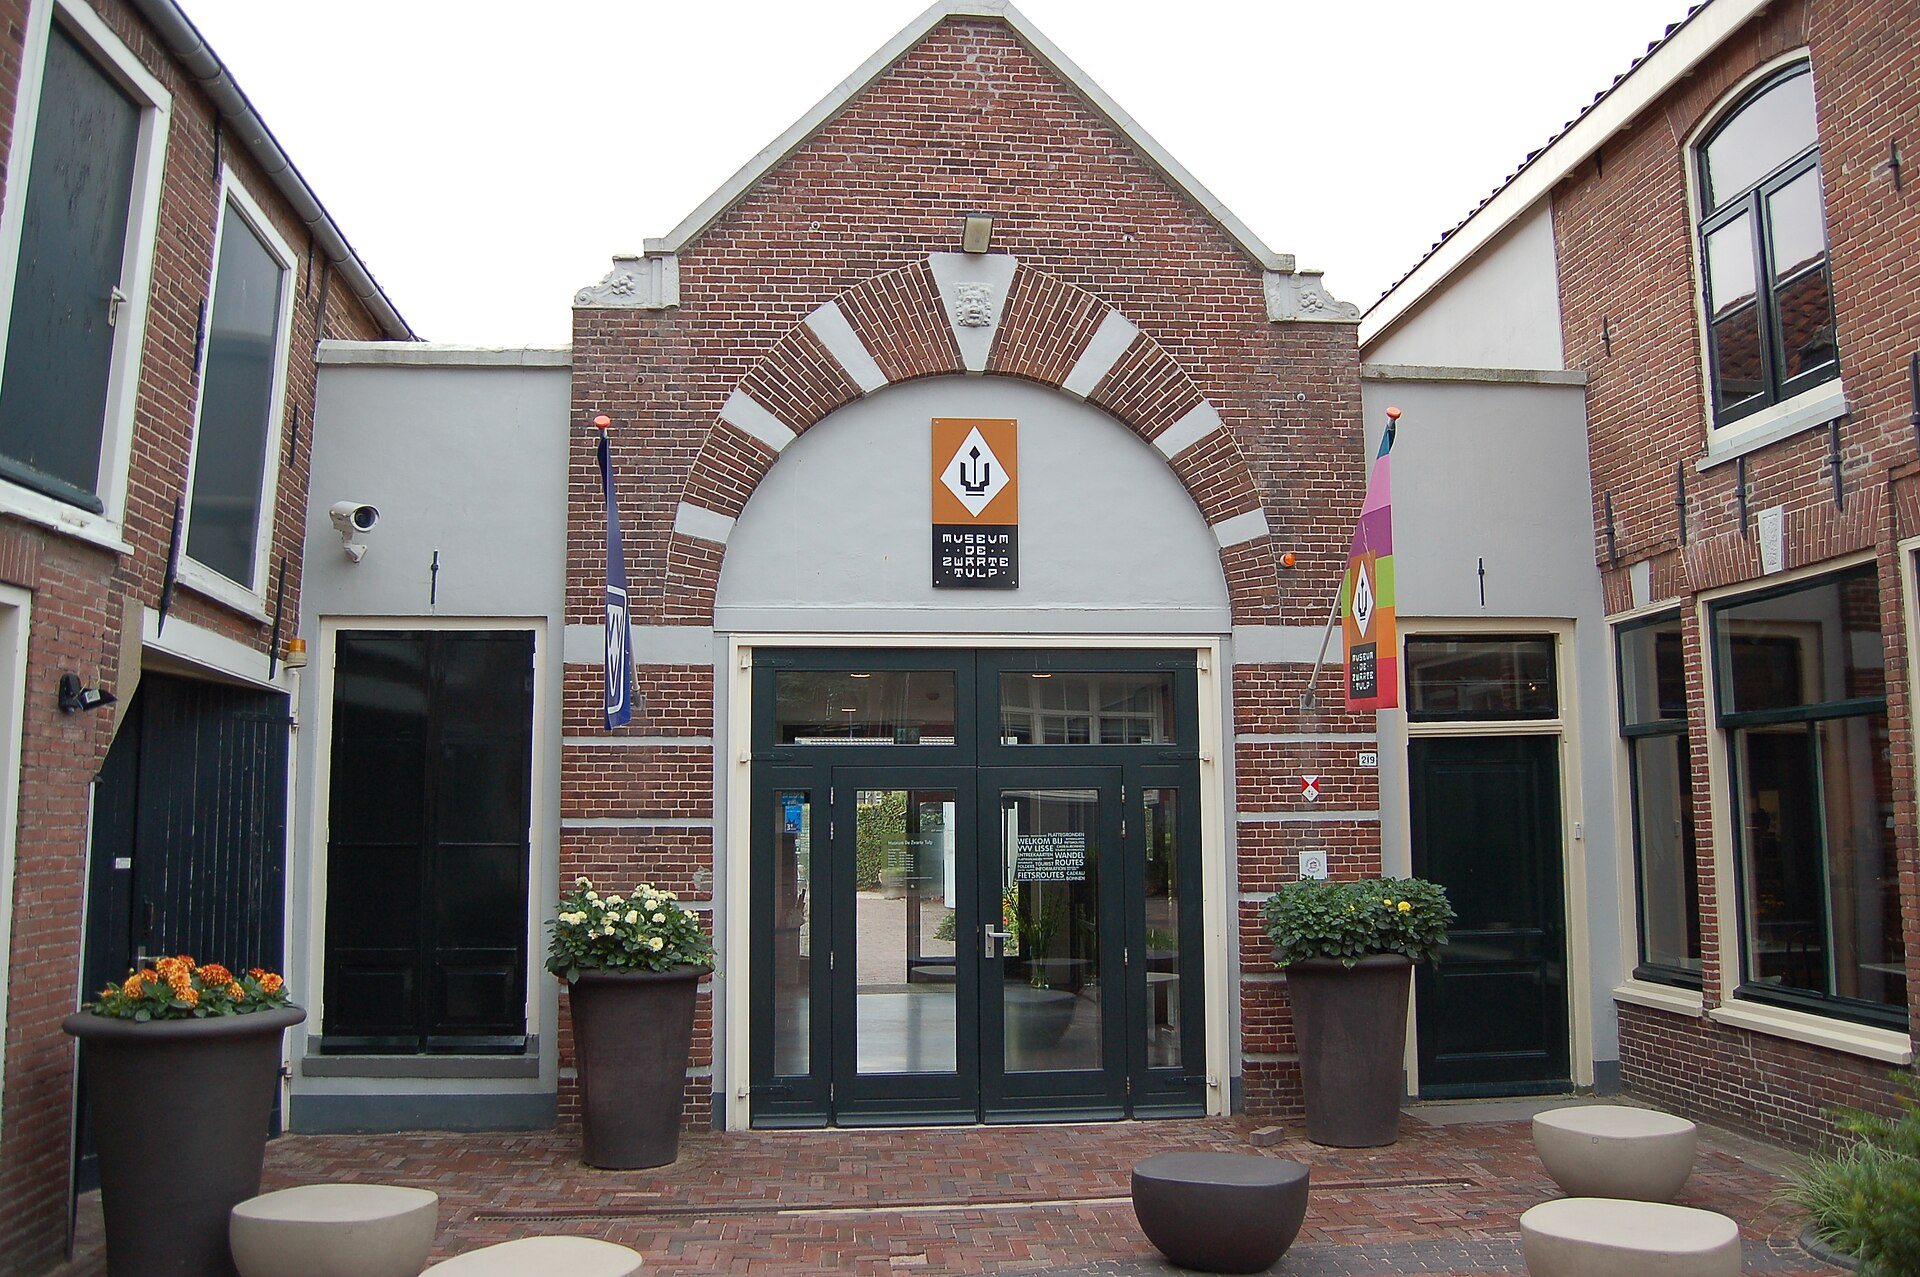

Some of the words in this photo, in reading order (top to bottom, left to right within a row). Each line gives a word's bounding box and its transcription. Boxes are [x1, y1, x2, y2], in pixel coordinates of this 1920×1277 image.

[965, 546, 986, 555] DE
[942, 557, 1009, 567] ZWARTE
[1361, 755, 1375, 764] 219
[1017, 871, 1065, 879] FIETSROUTES
